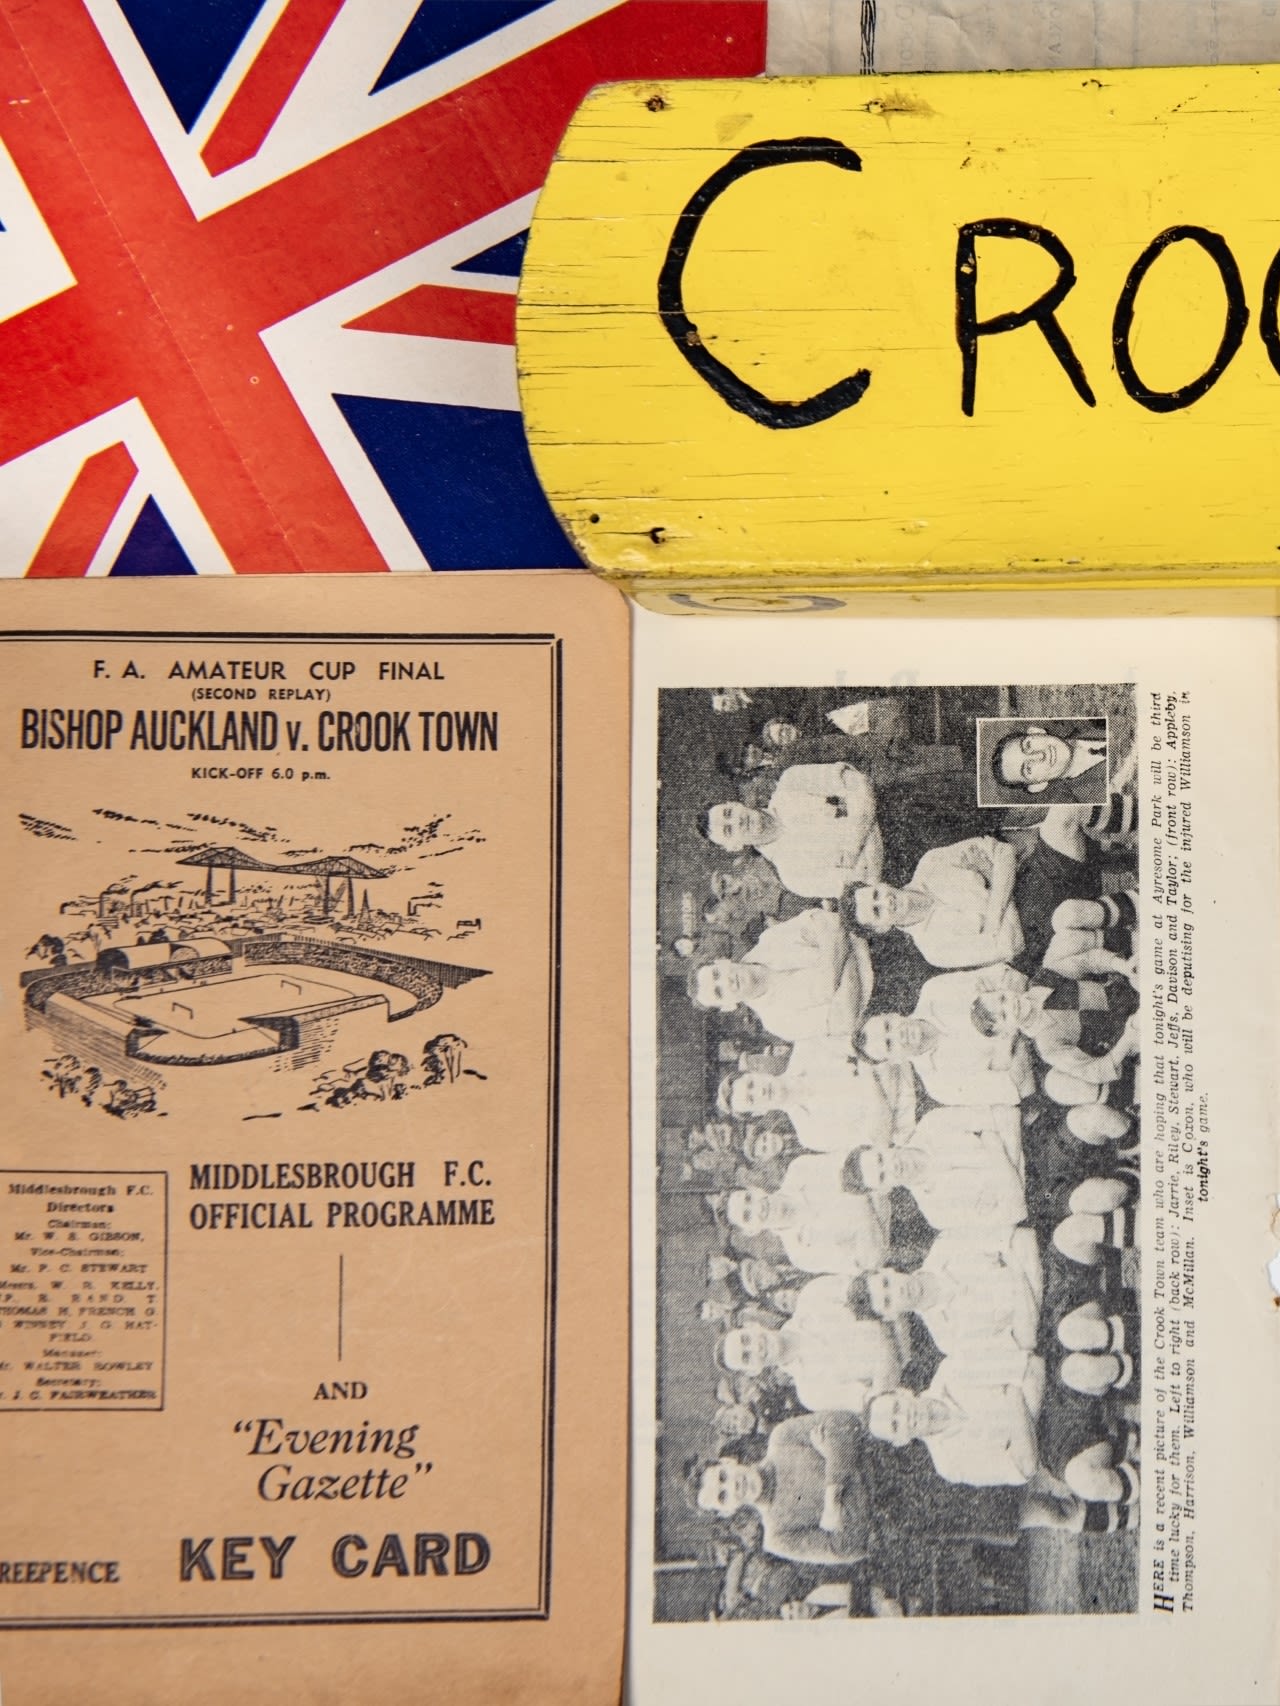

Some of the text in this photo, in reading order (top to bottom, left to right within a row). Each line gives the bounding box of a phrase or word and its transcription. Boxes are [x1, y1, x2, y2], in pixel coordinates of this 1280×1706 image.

[167, 660, 287, 681] AMATEUR
[308, 660, 356, 681] CUP
[378, 661, 445, 681] FINAL
[191, 687, 332, 703] (SECOND REPLAY)
[1150, 692, 1162, 726] third
[20, 708, 498, 753] BISHOP AUCKLAND v. CROOK TOWN
[1150, 735, 1162, 751] be
[191, 766, 331, 782] KICK-OFF 6.0 p.m.
[1150, 760, 1162, 785] will
[1150, 794, 1162, 828] Park
[1151, 837, 1165, 905] Ayresome
[1151, 914, 1164, 929] at
[1153, 938, 1166, 976] game
[1152, 1055, 1165, 1085] that
[1153, 1092, 1168, 1142] hoping
[189, 1159, 492, 1191] MIDDLESBROUGH F.C.
[1154, 1149, 1165, 1172] are
[7, 1183, 117, 1197] Middlesbrough
[1152, 1179, 1165, 1209] who
[45, 1201, 115, 1214] Directors
[189, 1198, 496, 1231] OFFICIAL PROGRAMME
[1153, 1217, 1165, 1253] team
[1153, 1260, 1166, 1299] Town
[1153, 1306, 1166, 1350] Crook
[1153, 1356, 1166, 1381] the
[313, 1381, 368, 1401] AND
[1153, 1387, 1168, 1403] of
[1153, 1409, 1168, 1462] picture
[1153, 1469, 1166, 1515] recent
[1155, 1523, 1165, 1533] a
[179, 1535, 297, 1582] KEY
[331, 1532, 491, 1579] CARD
[1152, 1539, 1165, 1552] is
[1152, 1559, 1175, 1612] HERE
